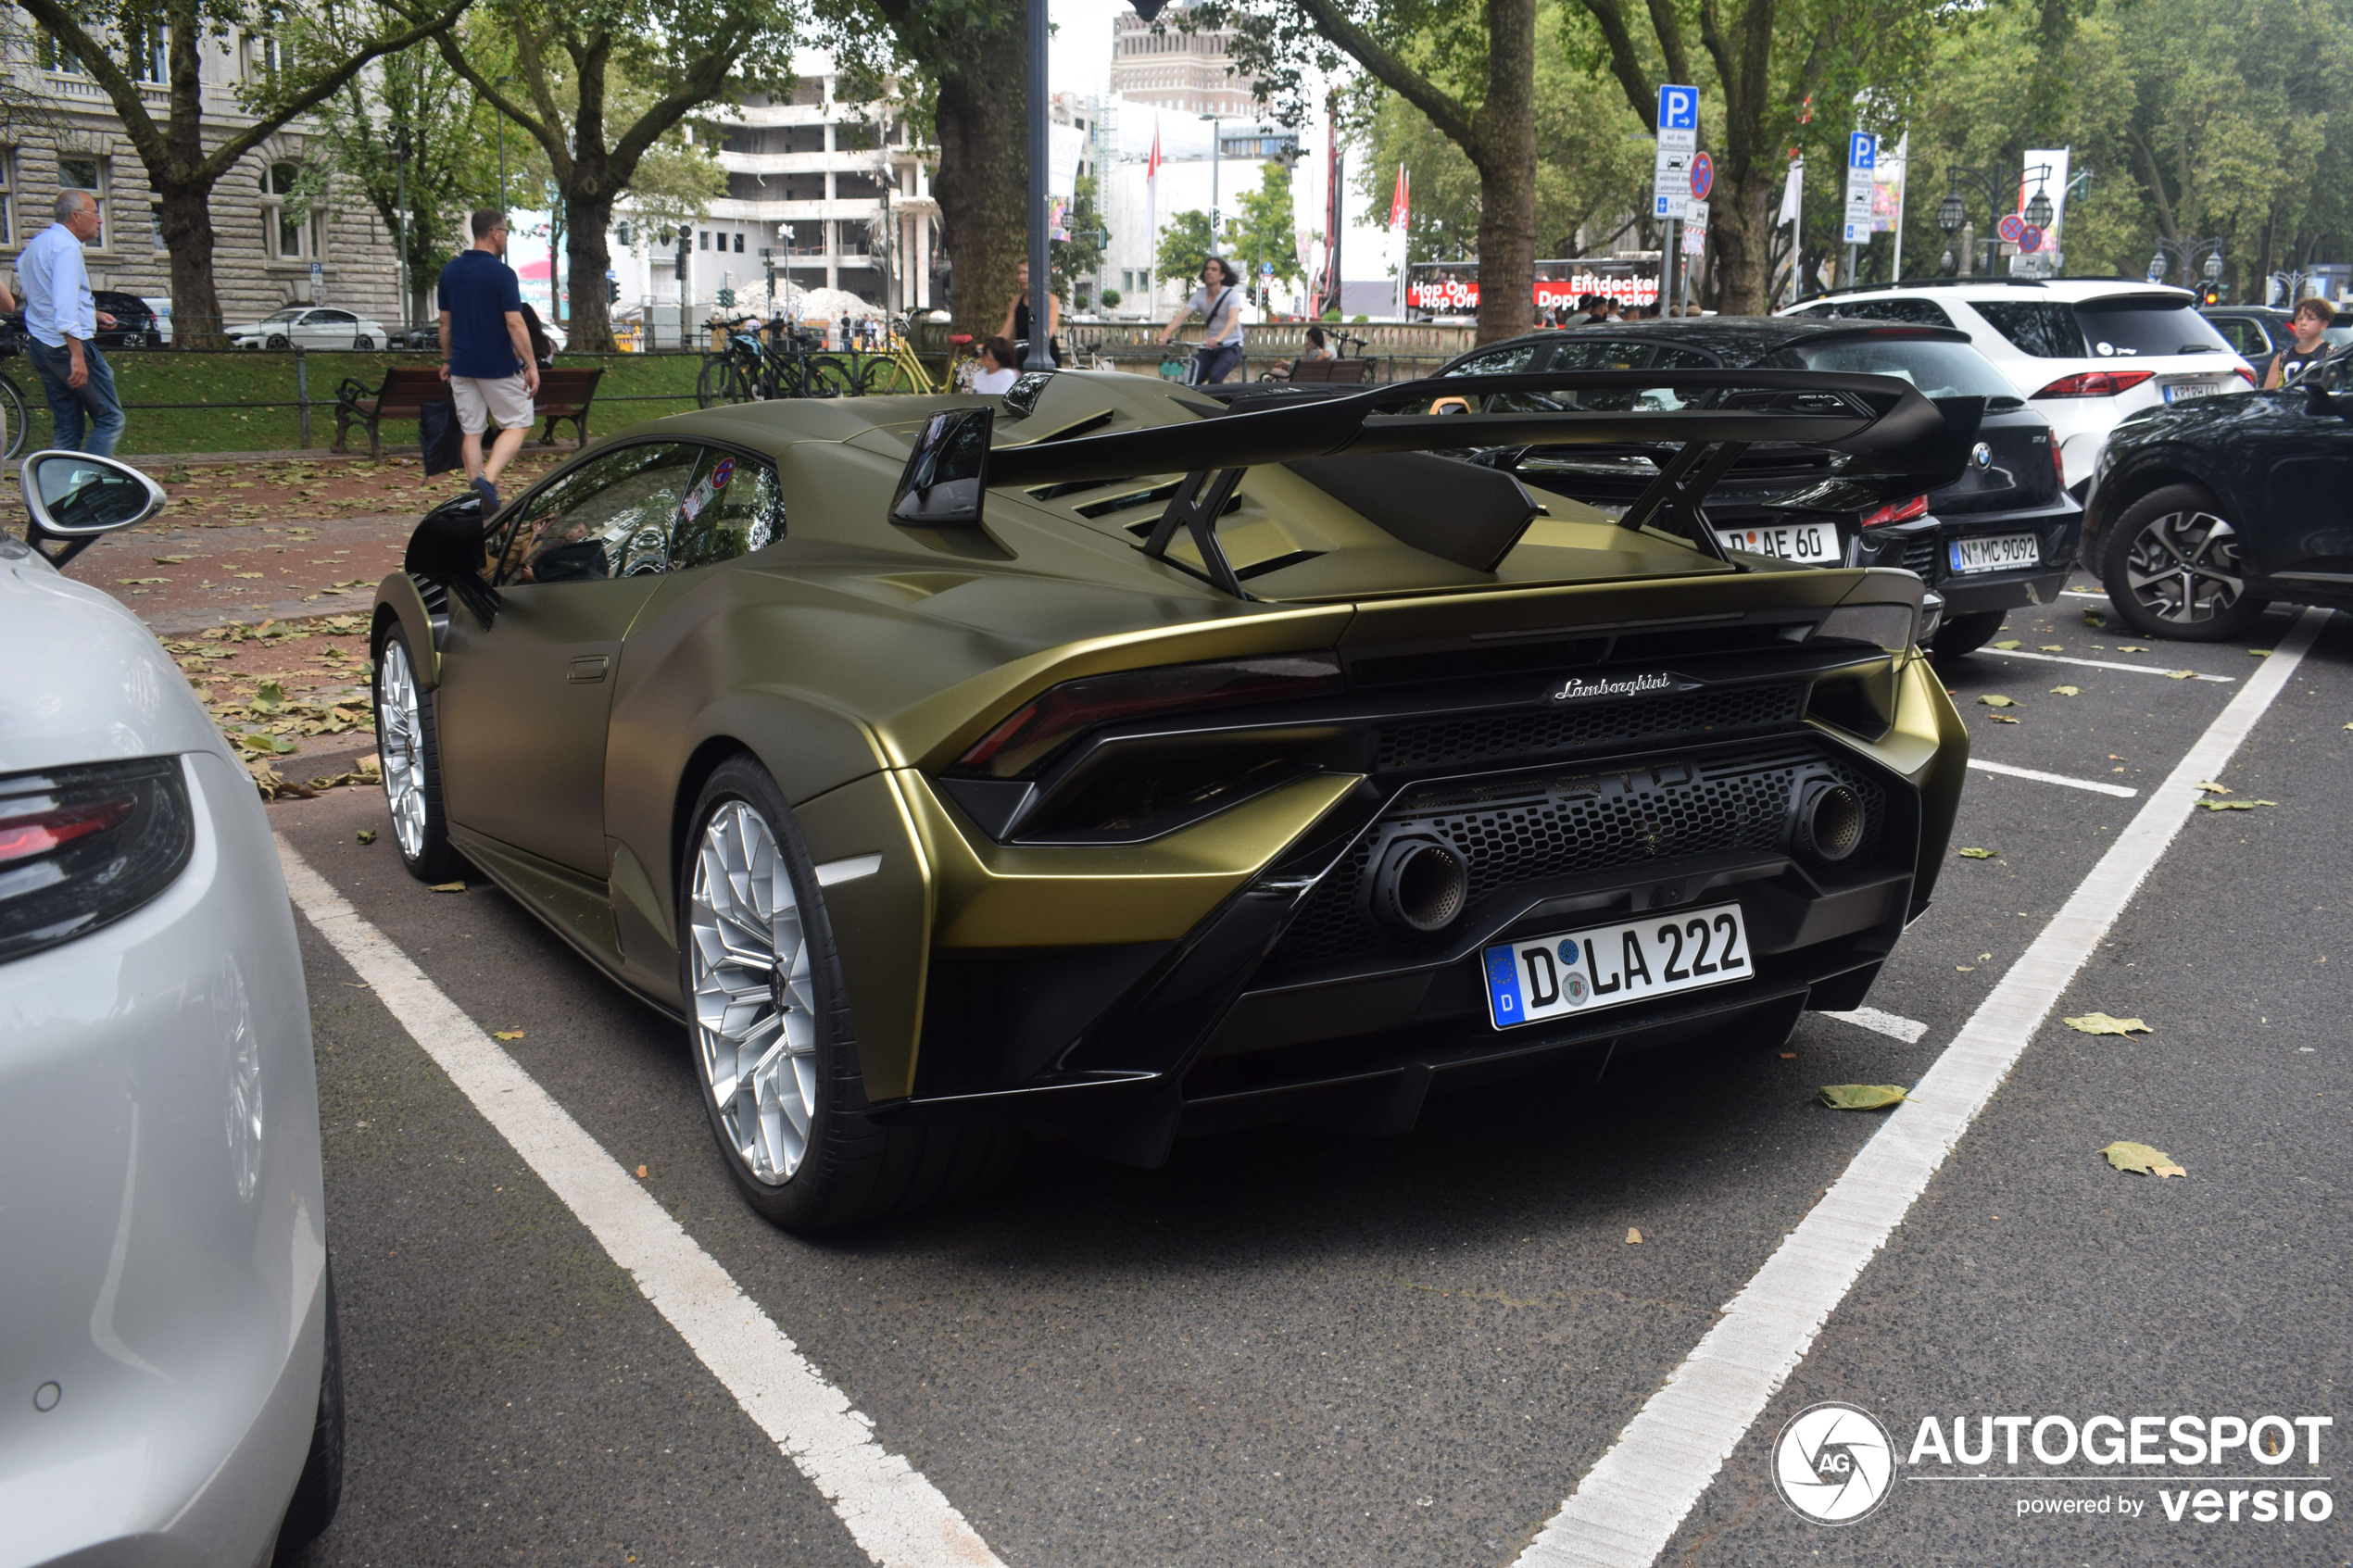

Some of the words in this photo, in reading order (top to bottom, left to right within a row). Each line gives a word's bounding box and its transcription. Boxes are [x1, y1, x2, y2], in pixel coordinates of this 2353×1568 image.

[1667, 91, 1690, 127] P
[1855, 136, 1871, 167] P
[312, 263, 321, 273] P
[1412, 281, 1443, 298] Hop
[1445, 280, 1468, 295] On
[1419, 294, 1451, 311] Hop
[1453, 293, 1478, 308] Off
[1764, 530, 1792, 558] AE
[1796, 528, 1822, 558] 60
[1960, 543, 1972, 565] N
[1981, 540, 2001, 563] MC
[2002, 537, 2036, 560] 9092
[1555, 672, 1670, 699] Lamborghini
[1521, 947, 1559, 1009] D
[1583, 930, 1653, 996] LA
[1657, 913, 1744, 983] 222
[1501, 994, 1514, 1011] D
